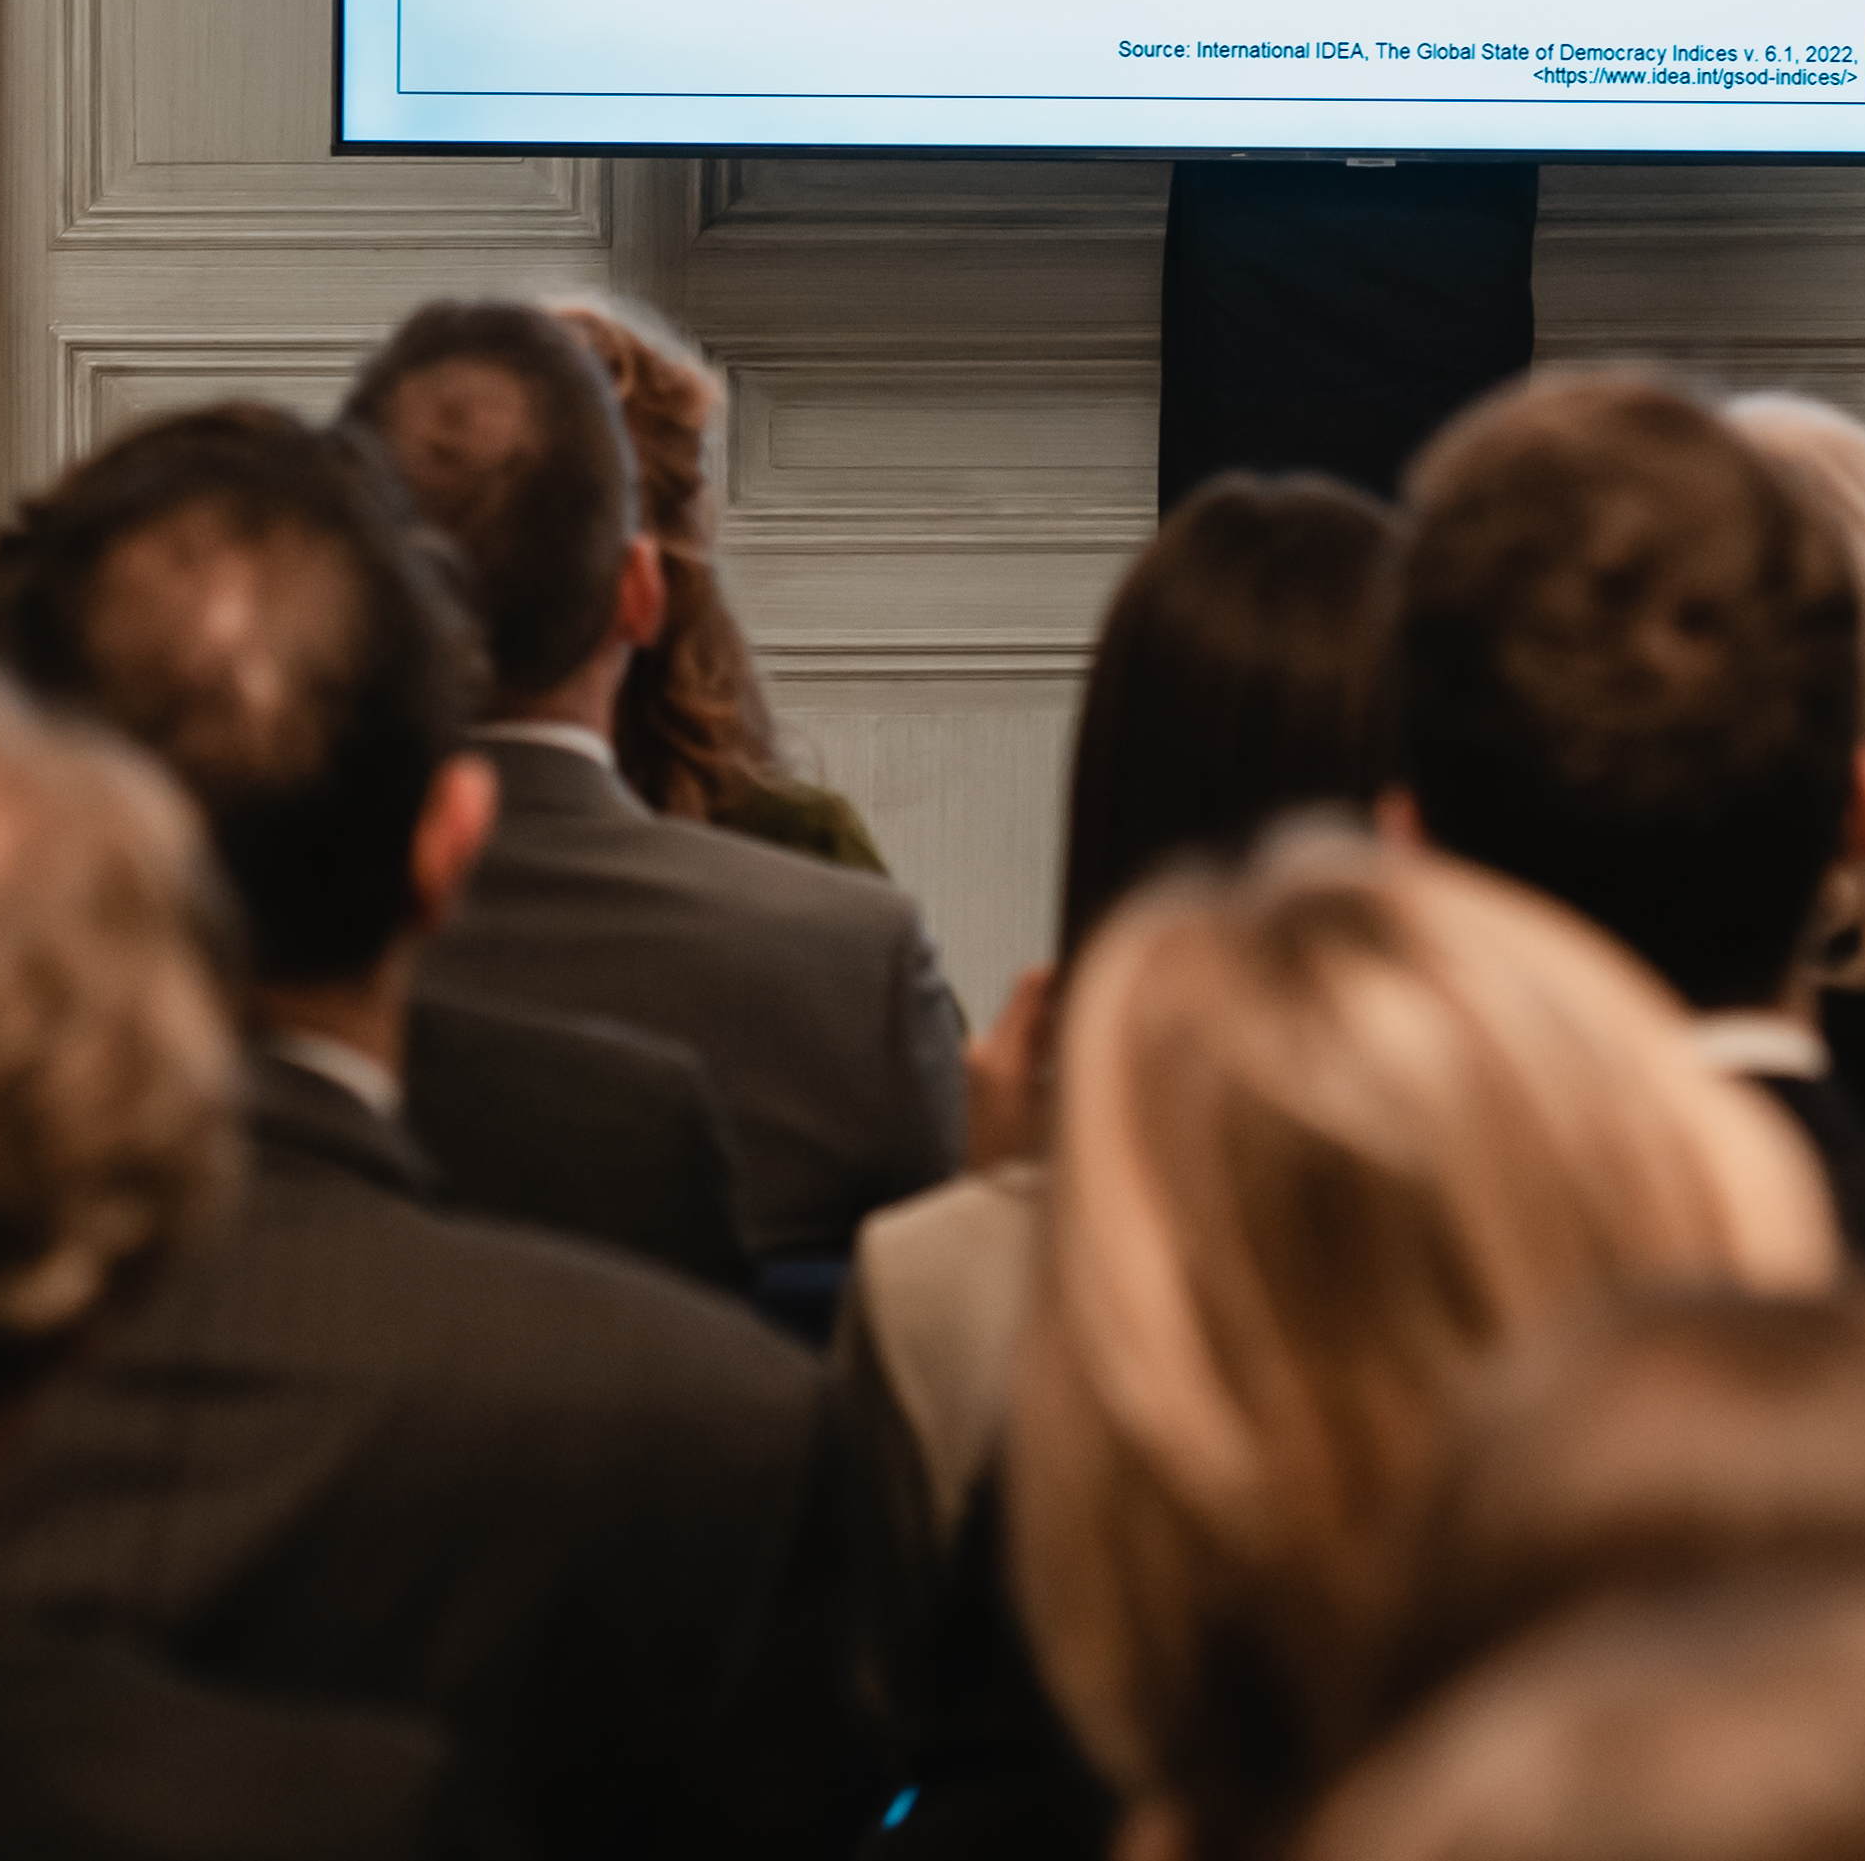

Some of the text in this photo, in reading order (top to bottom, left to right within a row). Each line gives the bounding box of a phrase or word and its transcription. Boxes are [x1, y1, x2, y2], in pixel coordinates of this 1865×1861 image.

[1118, 40, 1858, 66] Source: International IDEA, The Global State of Democracy Indices v. 6.1, 2022,
[1533, 67, 1859, 89] <https://www.idea.int/gsod-indices/>
